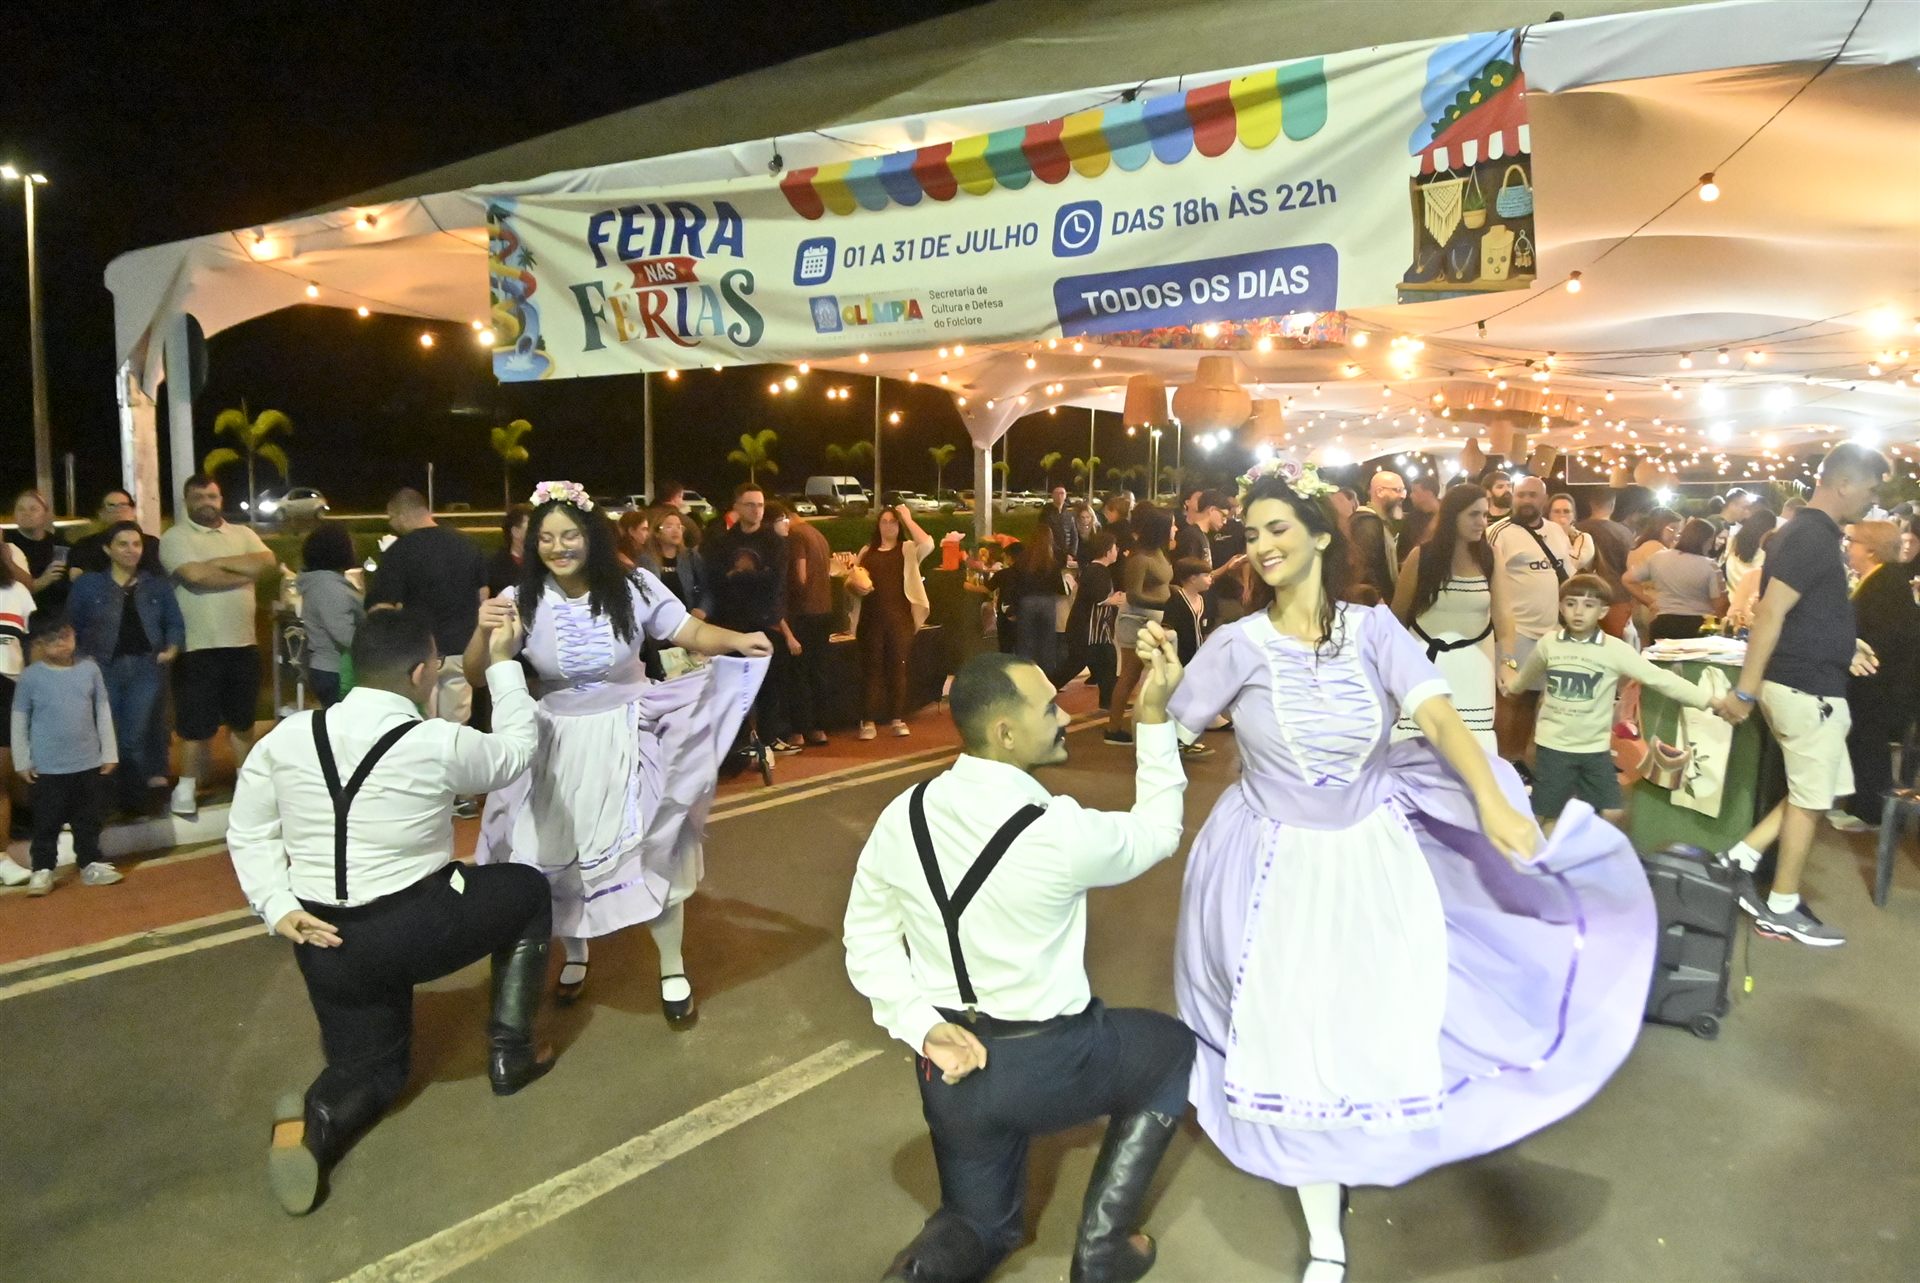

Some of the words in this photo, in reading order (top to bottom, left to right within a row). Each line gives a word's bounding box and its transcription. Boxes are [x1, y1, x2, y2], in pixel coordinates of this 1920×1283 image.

[1111, 205, 1164, 235] DAS
[1173, 197, 1219, 226] 18h
[1228, 185, 1269, 219] ÀS
[1276, 179, 1337, 211] 22h
[588, 201, 744, 268] FEIRA
[844, 245, 865, 268] 01
[870, 243, 885, 266] A
[892, 239, 915, 263] 31
[920, 234, 951, 260] DE
[956, 222, 1039, 255] JULHO
[644, 262, 676, 282] NAS
[1081, 282, 1183, 316] TODOS
[1190, 275, 1230, 304] OS
[1238, 265, 1310, 300] DIAS
[569, 269, 764, 352] FÉRIAS
[929, 286, 975, 300] Secretaria
[976, 285, 988, 295] de
[931, 304, 963, 314] Cultura
[964, 303, 970, 311] e
[972, 299, 1003, 310] Defesa
[934, 319, 945, 328] do
[946, 316, 983, 327] Folclore
[1546, 670, 1604, 700] STAY
